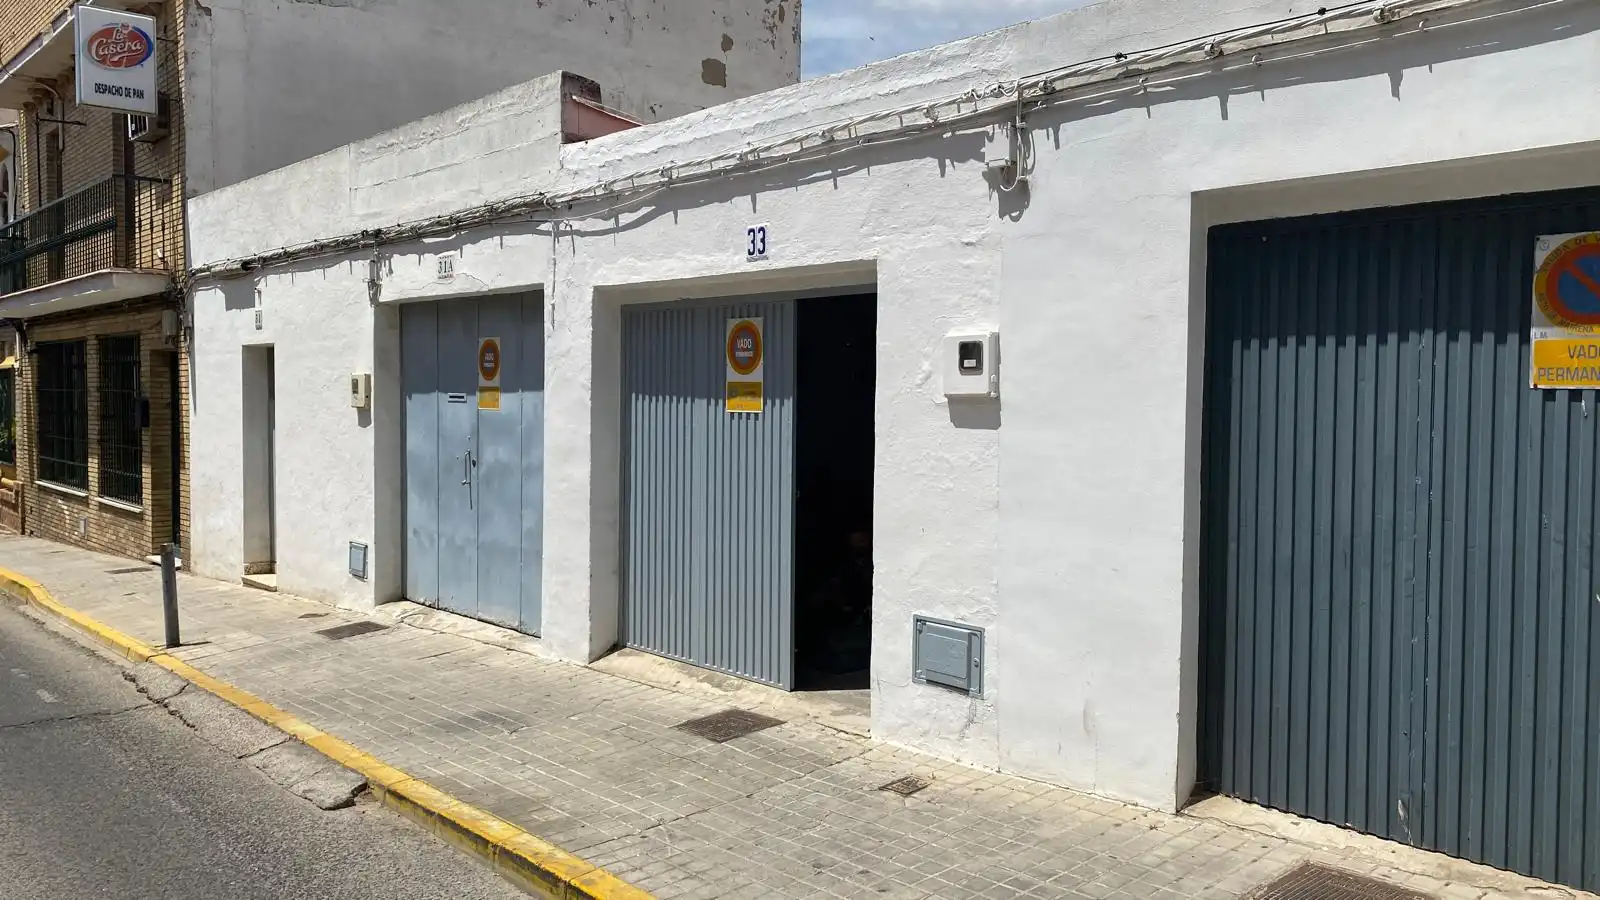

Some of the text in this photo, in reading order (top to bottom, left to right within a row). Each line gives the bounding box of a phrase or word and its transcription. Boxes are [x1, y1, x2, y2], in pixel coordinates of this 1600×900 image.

[112, 27, 128, 42] La
[91, 38, 143, 61] Casera
[94, 82, 145, 100] DESPACHO DE PAN
[747, 226, 766, 256] 33
[437, 259, 454, 274] 31A
[736, 338, 753, 349] VADO
[1567, 344, 1600, 360] VAD
